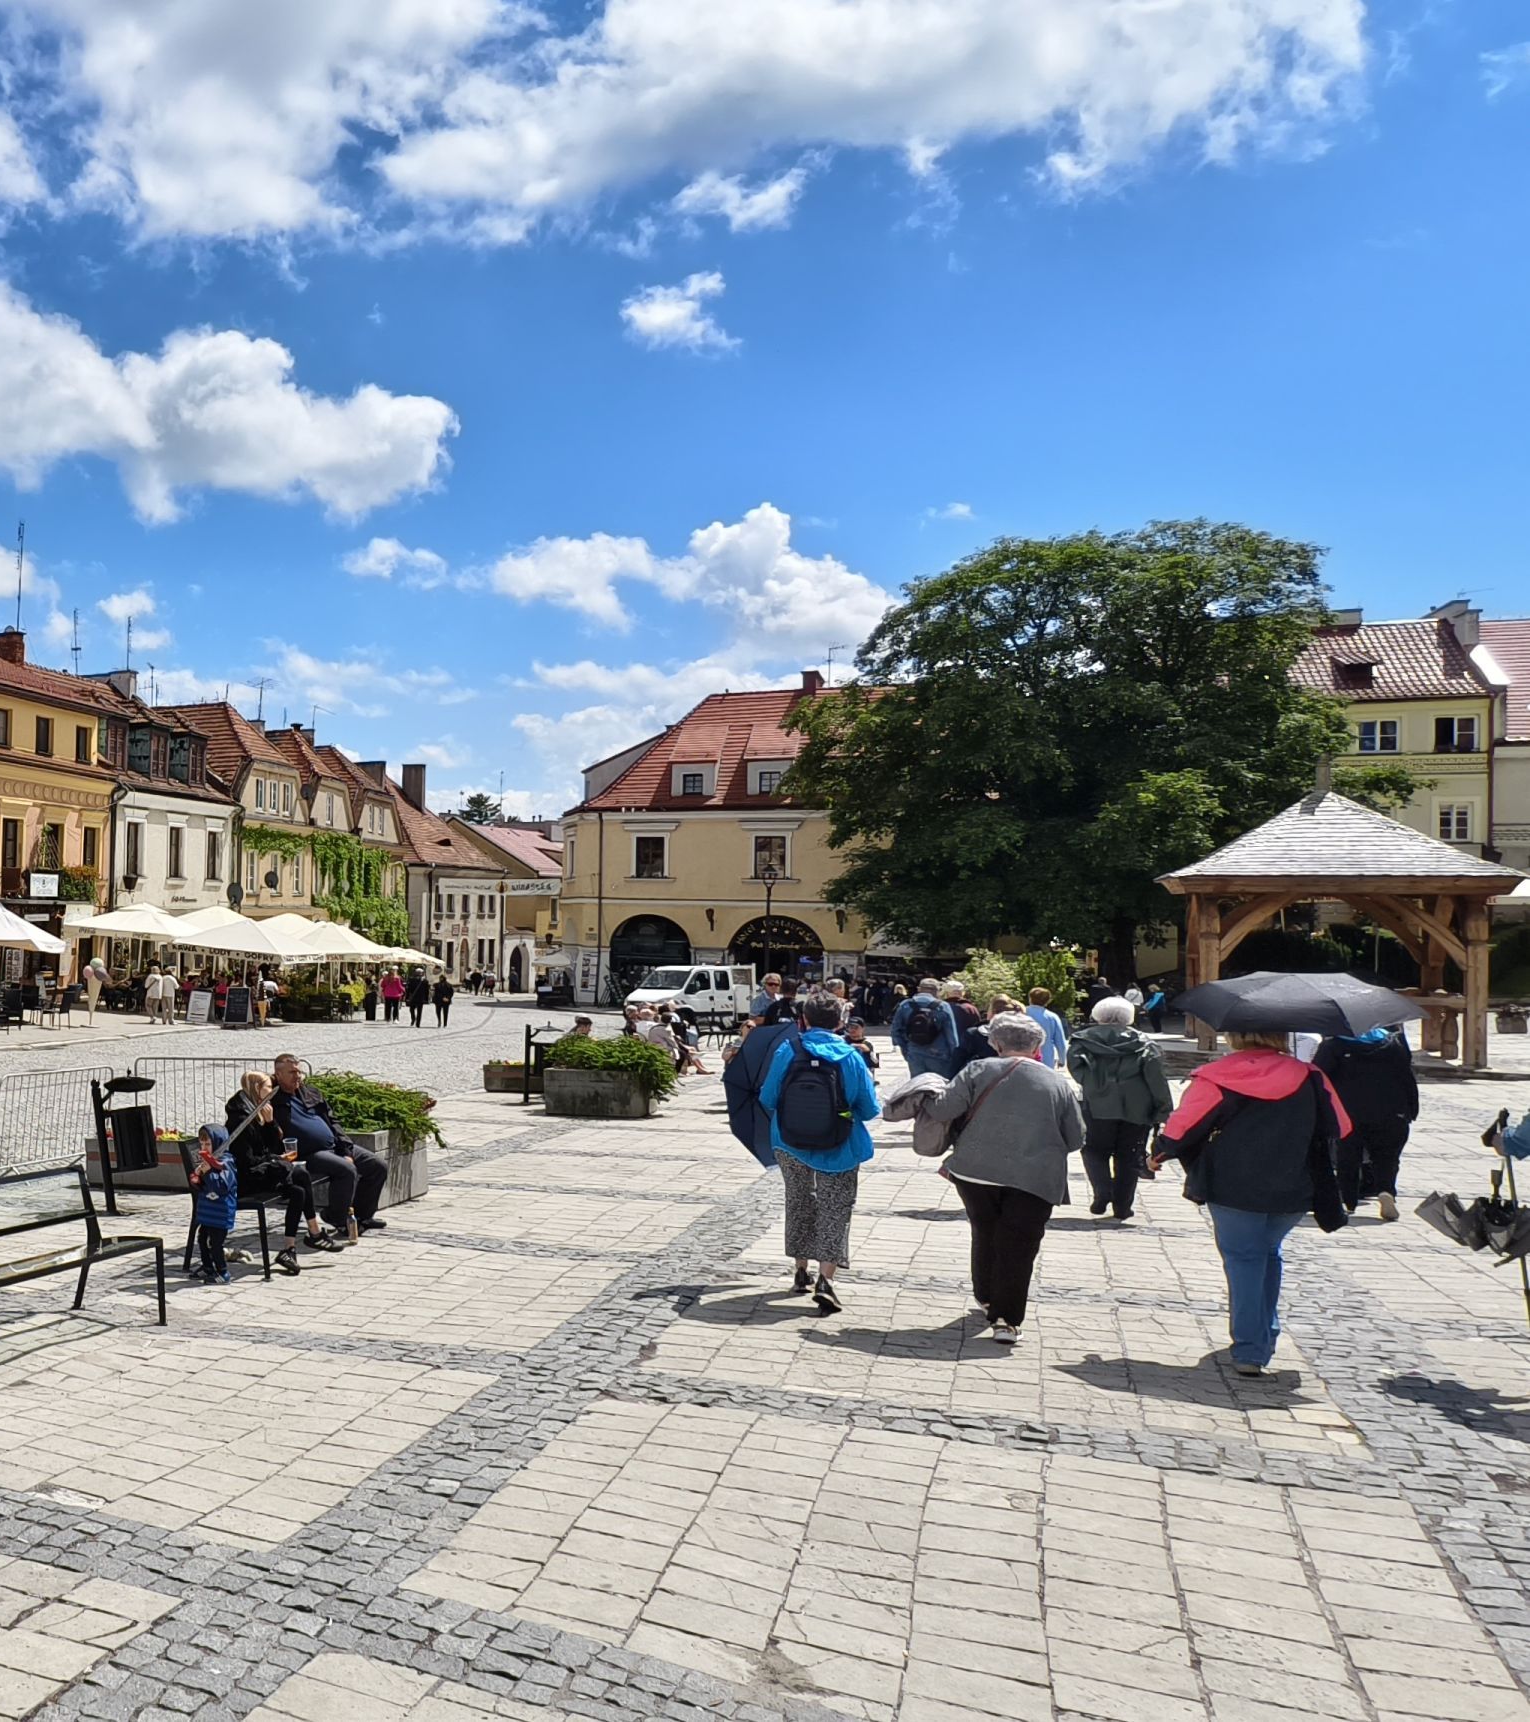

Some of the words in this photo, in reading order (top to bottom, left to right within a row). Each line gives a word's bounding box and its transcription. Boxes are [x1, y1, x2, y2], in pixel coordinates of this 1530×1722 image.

[172, 944, 197, 952] KAWA
[209, 948, 231, 956] LODY
[245, 951, 274, 961] GOFRY
